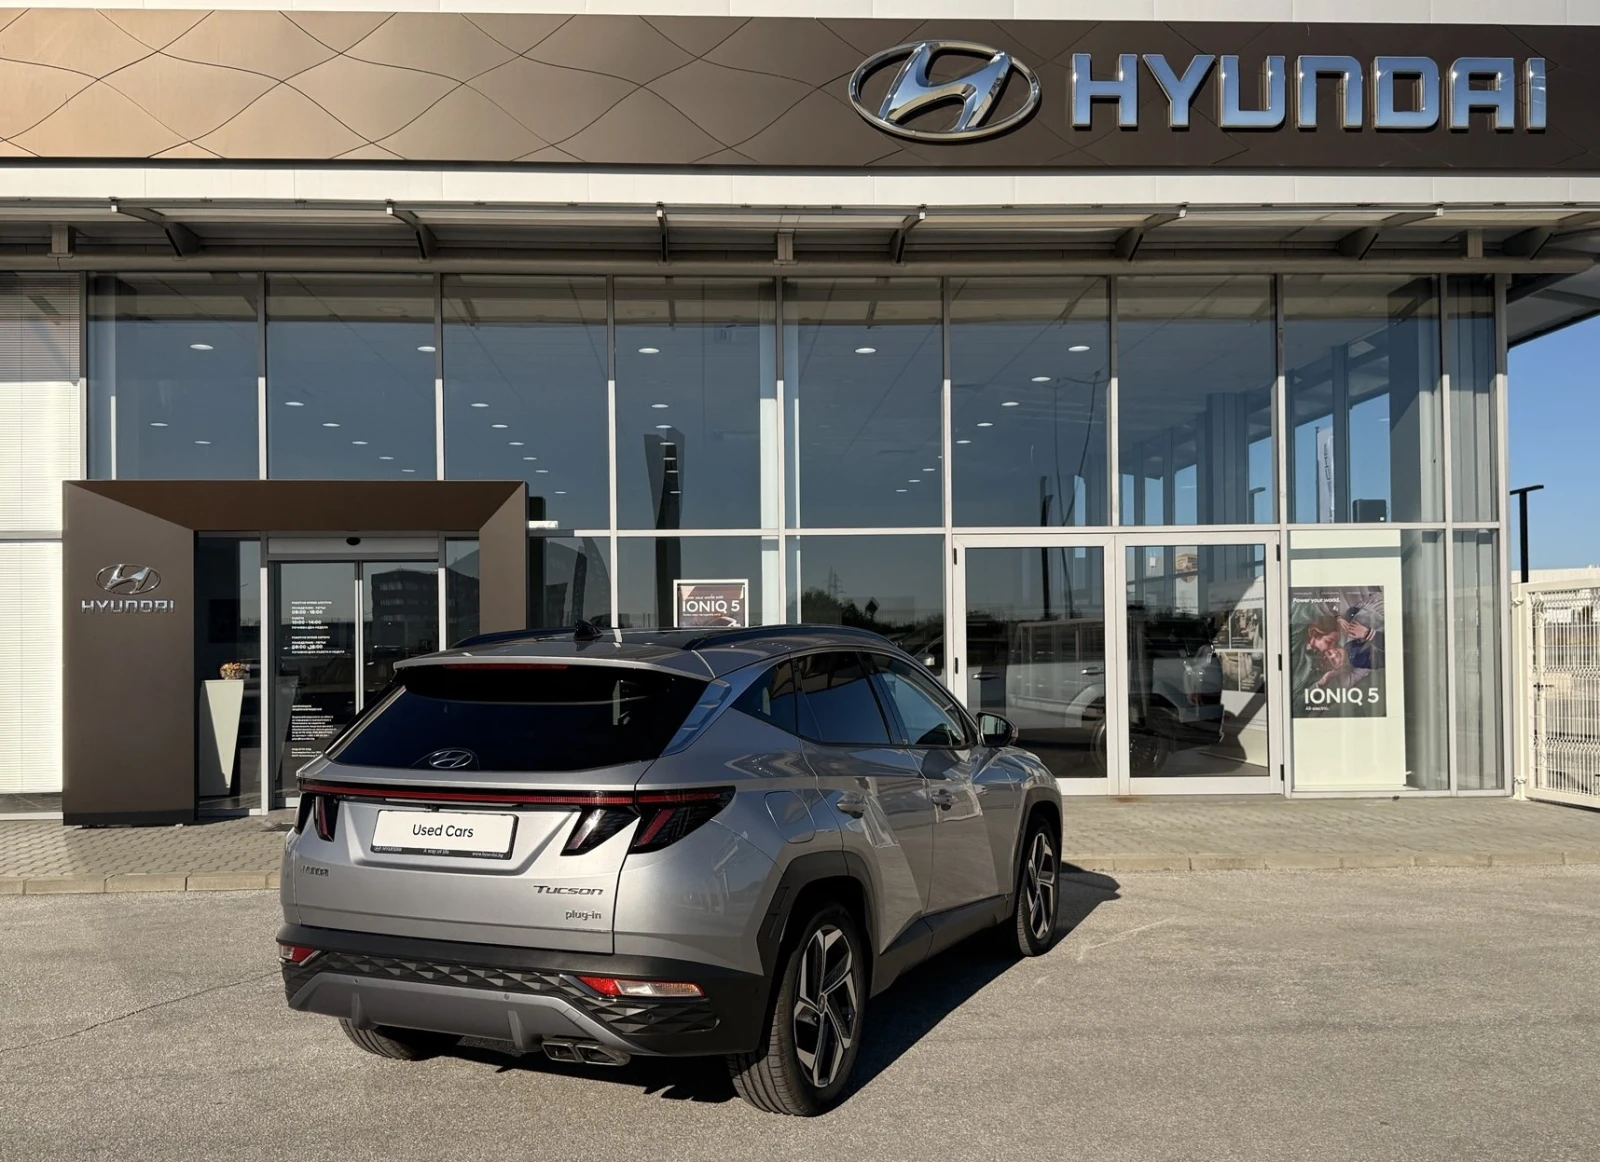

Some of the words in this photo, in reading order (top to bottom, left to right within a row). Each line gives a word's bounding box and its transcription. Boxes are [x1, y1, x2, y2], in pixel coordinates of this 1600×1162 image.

[1071, 53, 1546, 129] HYUNDAI
[81, 600, 175, 613] HYUNDAI
[682, 600, 727, 614] IONIQ
[731, 600, 740, 612] 5
[1304, 688, 1363, 706] IONIQ
[1367, 687, 1379, 703] 5
[412, 824, 443, 837] Used
[445, 825, 474, 838] Cars
[565, 909, 602, 921] plug-in
